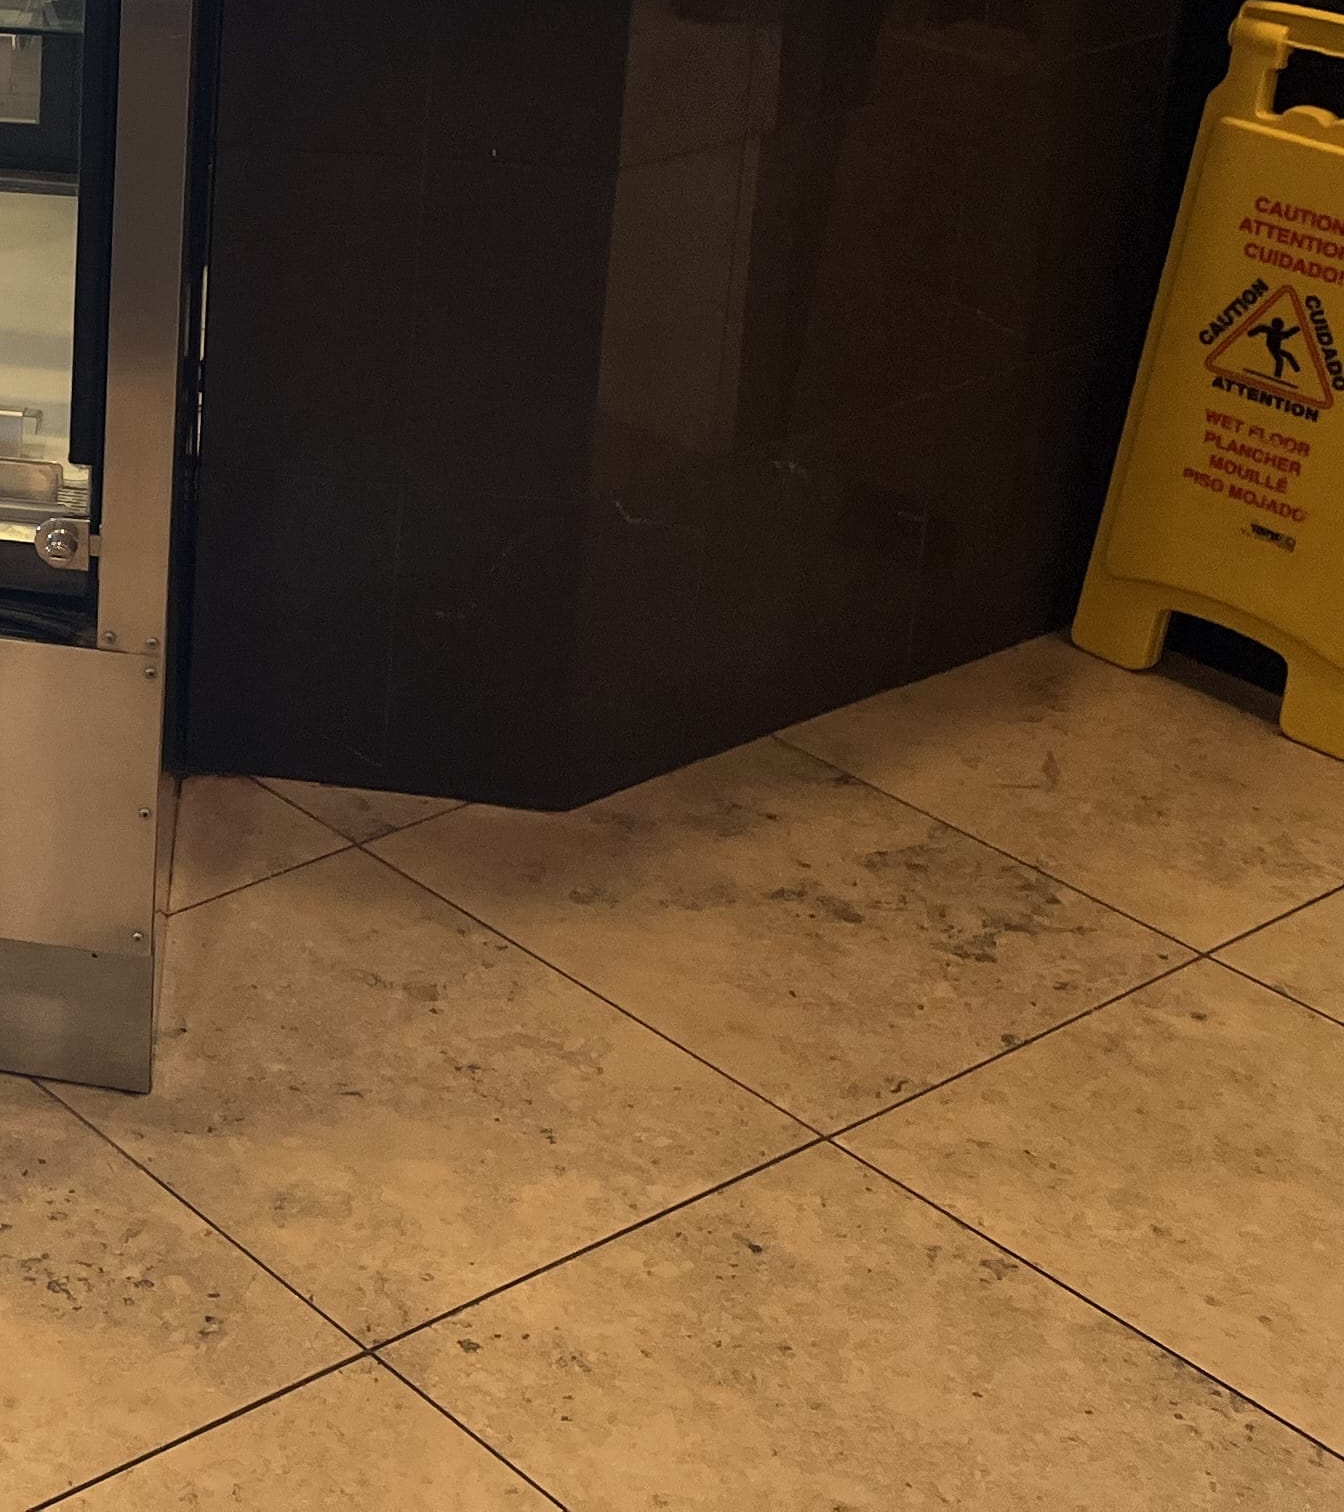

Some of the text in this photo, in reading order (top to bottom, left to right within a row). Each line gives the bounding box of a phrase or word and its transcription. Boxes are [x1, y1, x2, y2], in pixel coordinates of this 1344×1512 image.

[1255, 195, 1344, 237] CAUTION
[1199, 278, 1269, 345] CAUTION
[1305, 294, 1344, 391] CUIDADO
[1206, 409, 1245, 433] WET
[1212, 375, 1319, 423] ATTENTION
[1204, 430, 1301, 476] PLANCHER
[1183, 467, 1305, 523] PISO MOJADO
